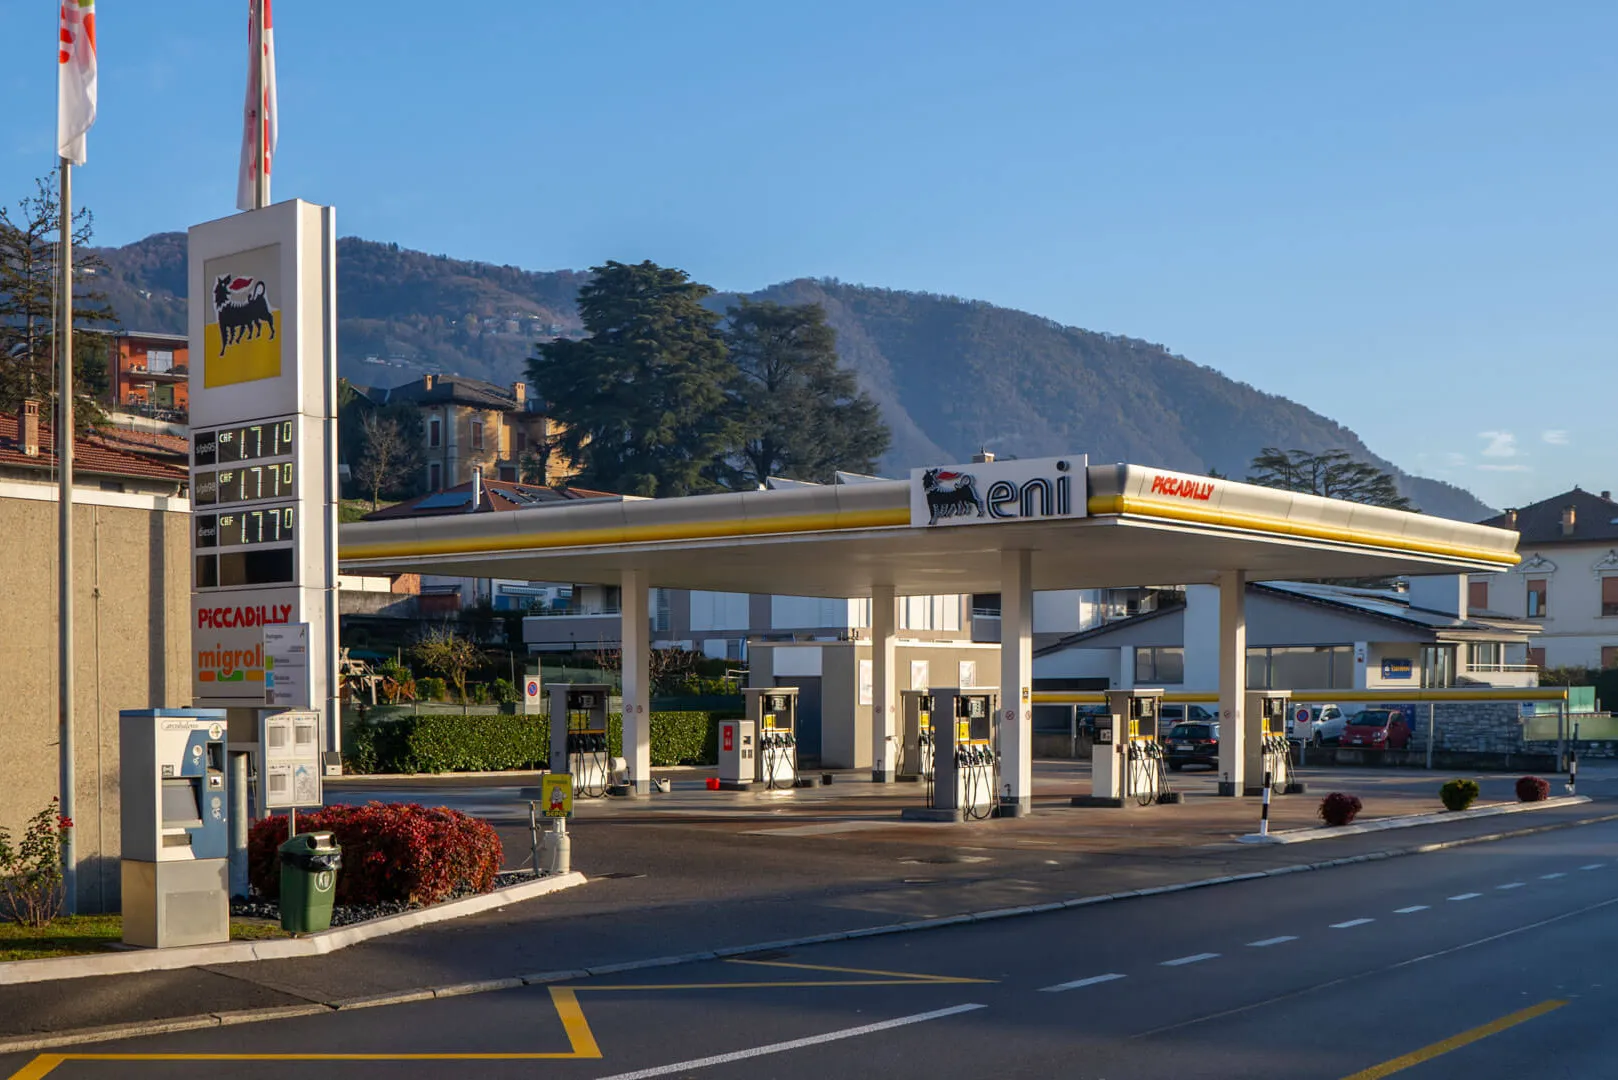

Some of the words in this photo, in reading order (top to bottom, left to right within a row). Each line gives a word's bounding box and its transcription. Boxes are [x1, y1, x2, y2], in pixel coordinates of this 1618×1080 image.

[219, 432, 233, 443] CHF
[240, 421, 292, 459] 1.710
[219, 472, 233, 483] CHF
[240, 463, 292, 500] 1.770
[987, 460, 1071, 519] eni
[219, 516, 234, 527] CHF
[241, 508, 293, 544] 1.770
